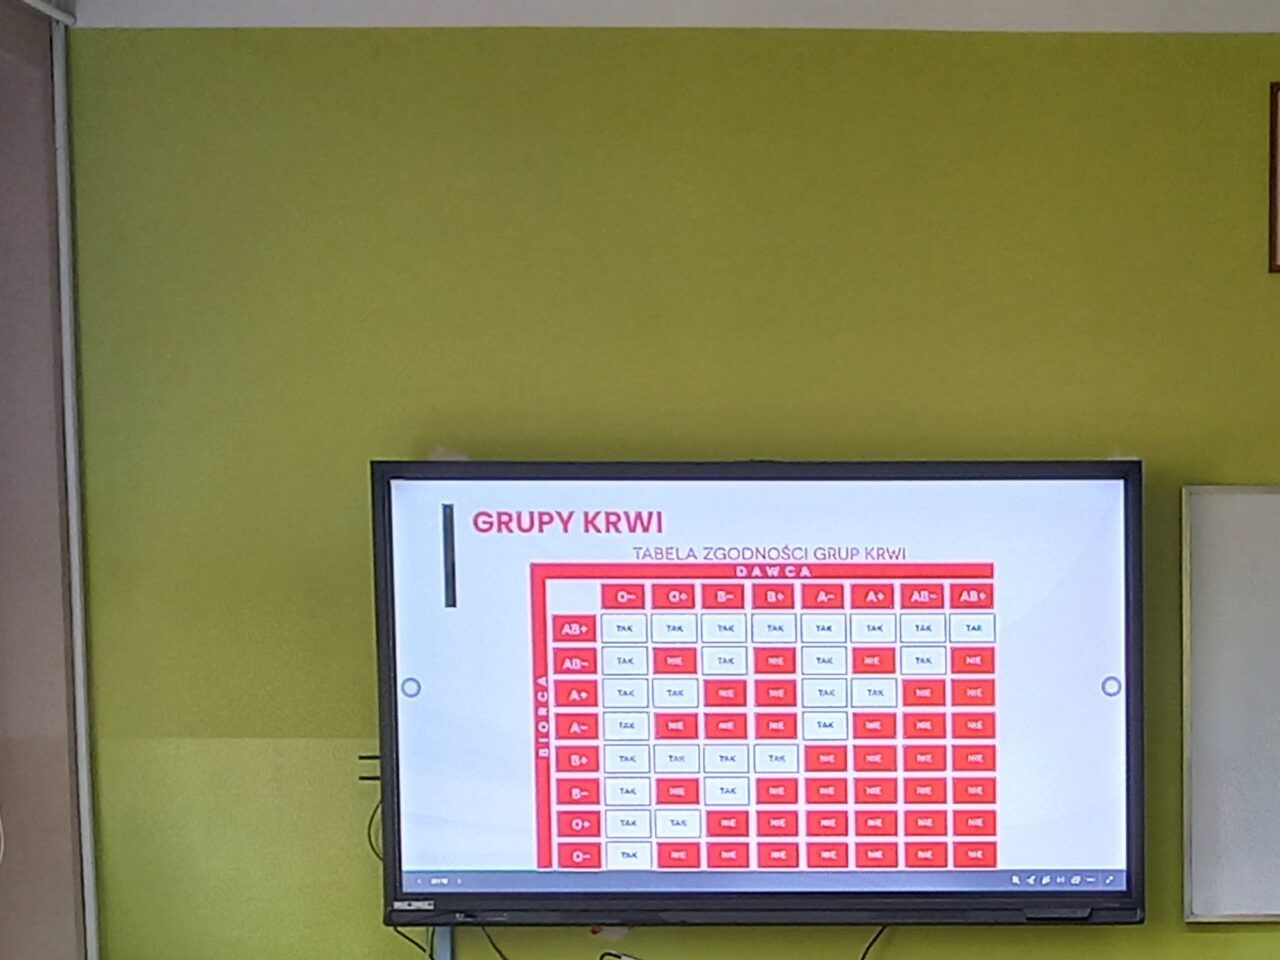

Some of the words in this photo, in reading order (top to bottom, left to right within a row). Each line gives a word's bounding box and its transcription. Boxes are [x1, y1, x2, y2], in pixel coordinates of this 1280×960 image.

[473, 511, 575, 534] GRUPY
[583, 511, 663, 534] KRWI
[633, 547, 698, 560] TABELA
[703, 544, 808, 560] ZGODNOŚCI
[813, 547, 859, 560] GRUP
[865, 547, 906, 560] KRWI
[736, 565, 812, 578] DAWCA
